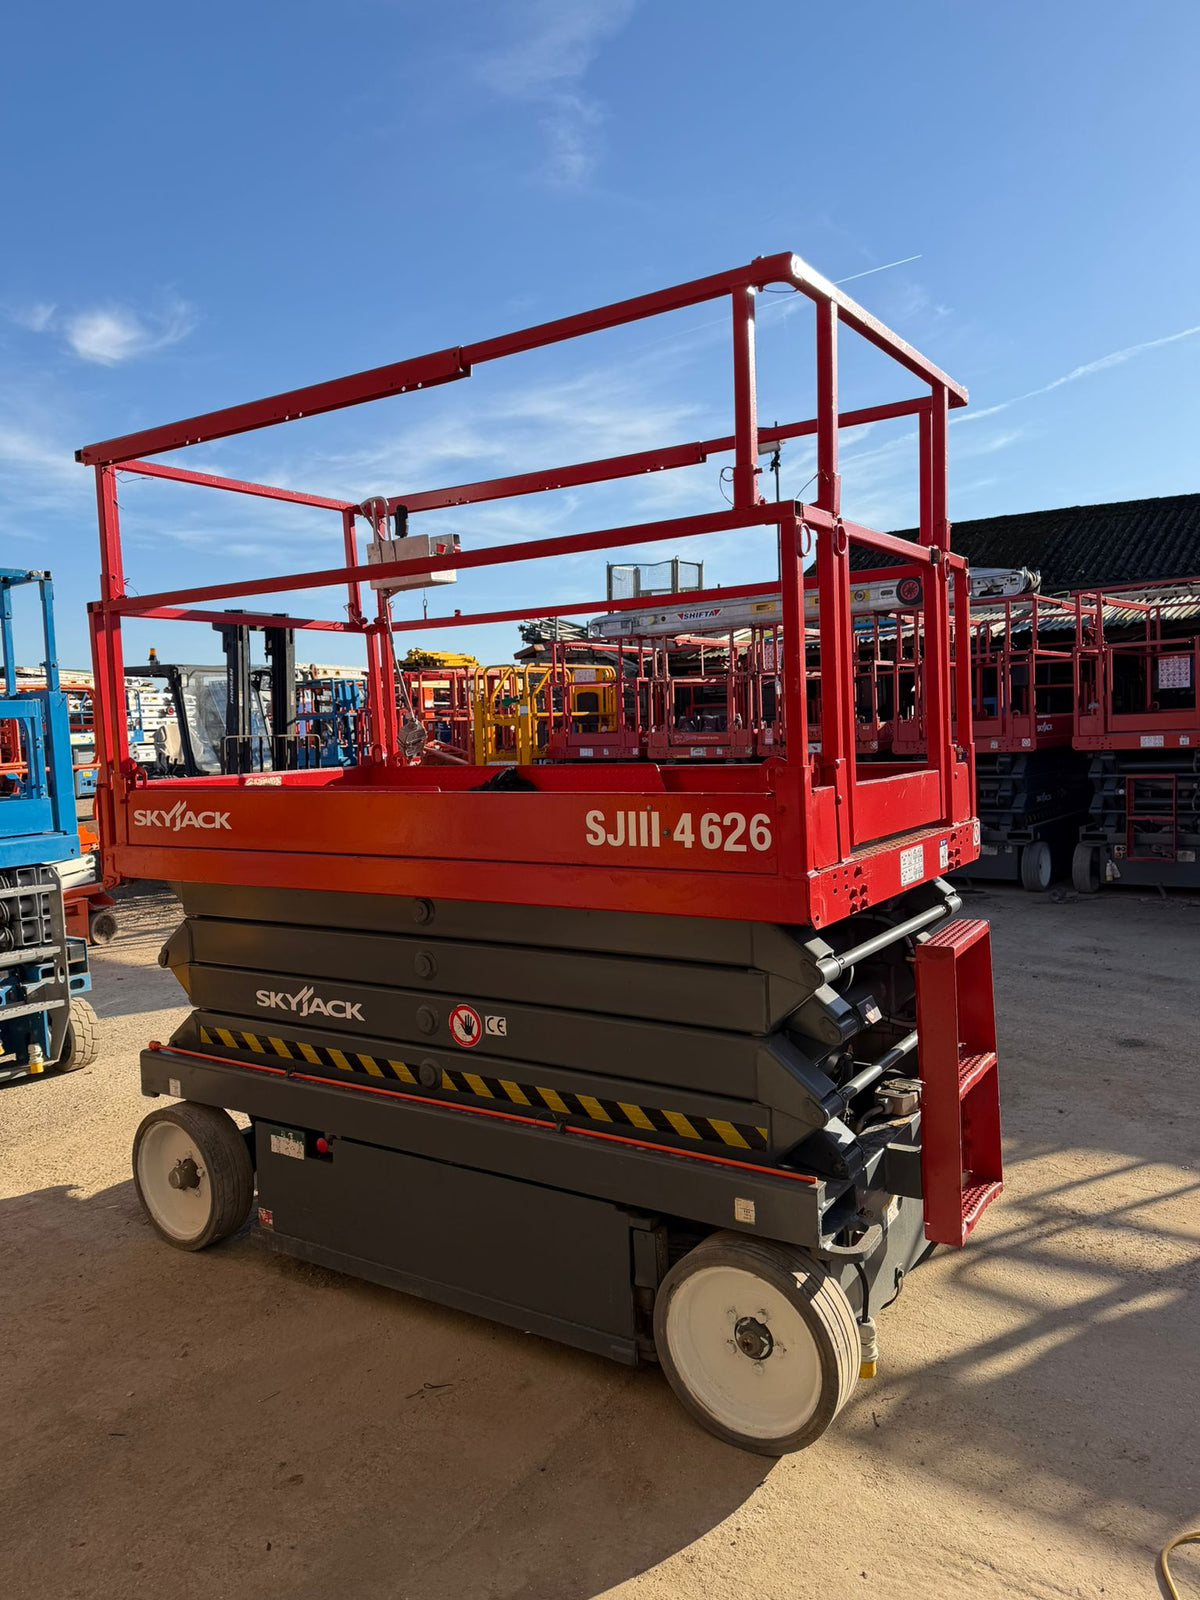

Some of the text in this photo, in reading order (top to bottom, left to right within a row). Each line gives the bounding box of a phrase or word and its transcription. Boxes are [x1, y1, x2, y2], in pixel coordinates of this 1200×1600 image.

[683, 609, 717, 620] SHIFTA
[133, 799, 233, 832] SKYJACK
[585, 809, 773, 853] SJIII 4626
[255, 985, 366, 1022] SKYJACK
[486, 1016, 506, 1035] CE
